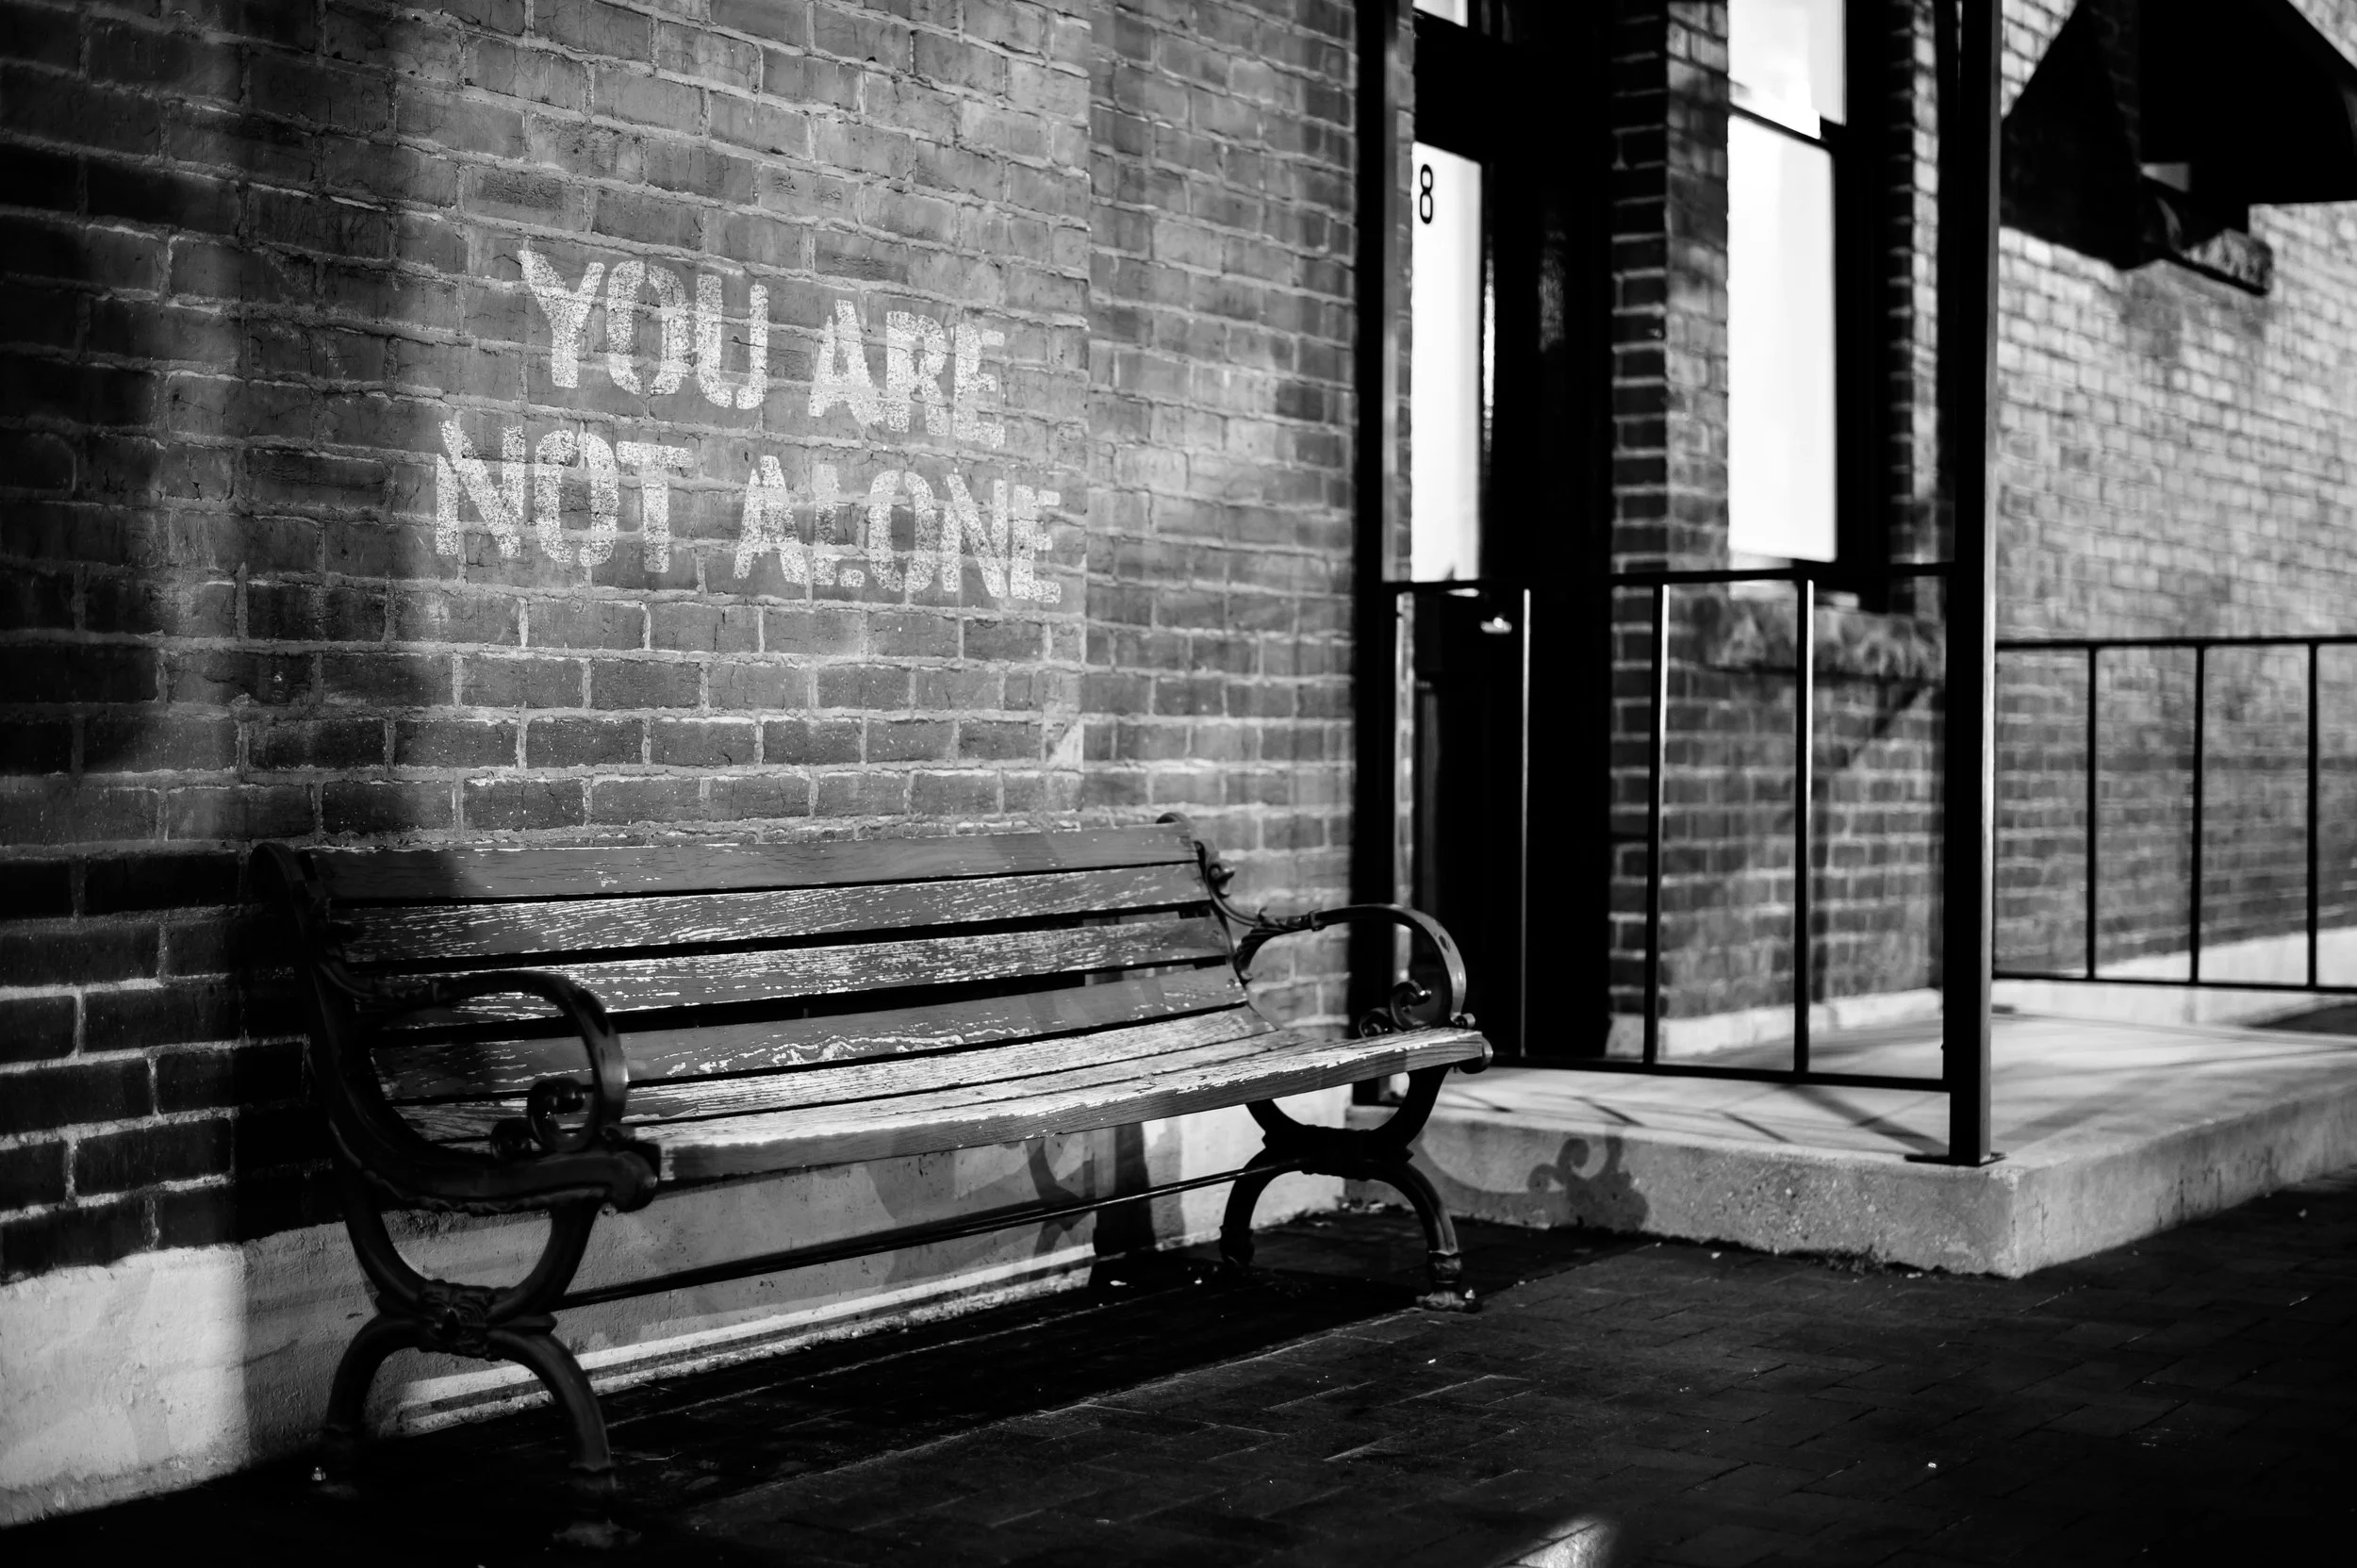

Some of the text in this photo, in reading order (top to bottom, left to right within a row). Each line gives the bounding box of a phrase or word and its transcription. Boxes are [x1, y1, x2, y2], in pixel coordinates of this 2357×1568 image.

[1420, 163, 1434, 225] 8
[517, 249, 1005, 447] YOU ARE
[436, 420, 1062, 603] NOT ALONE
